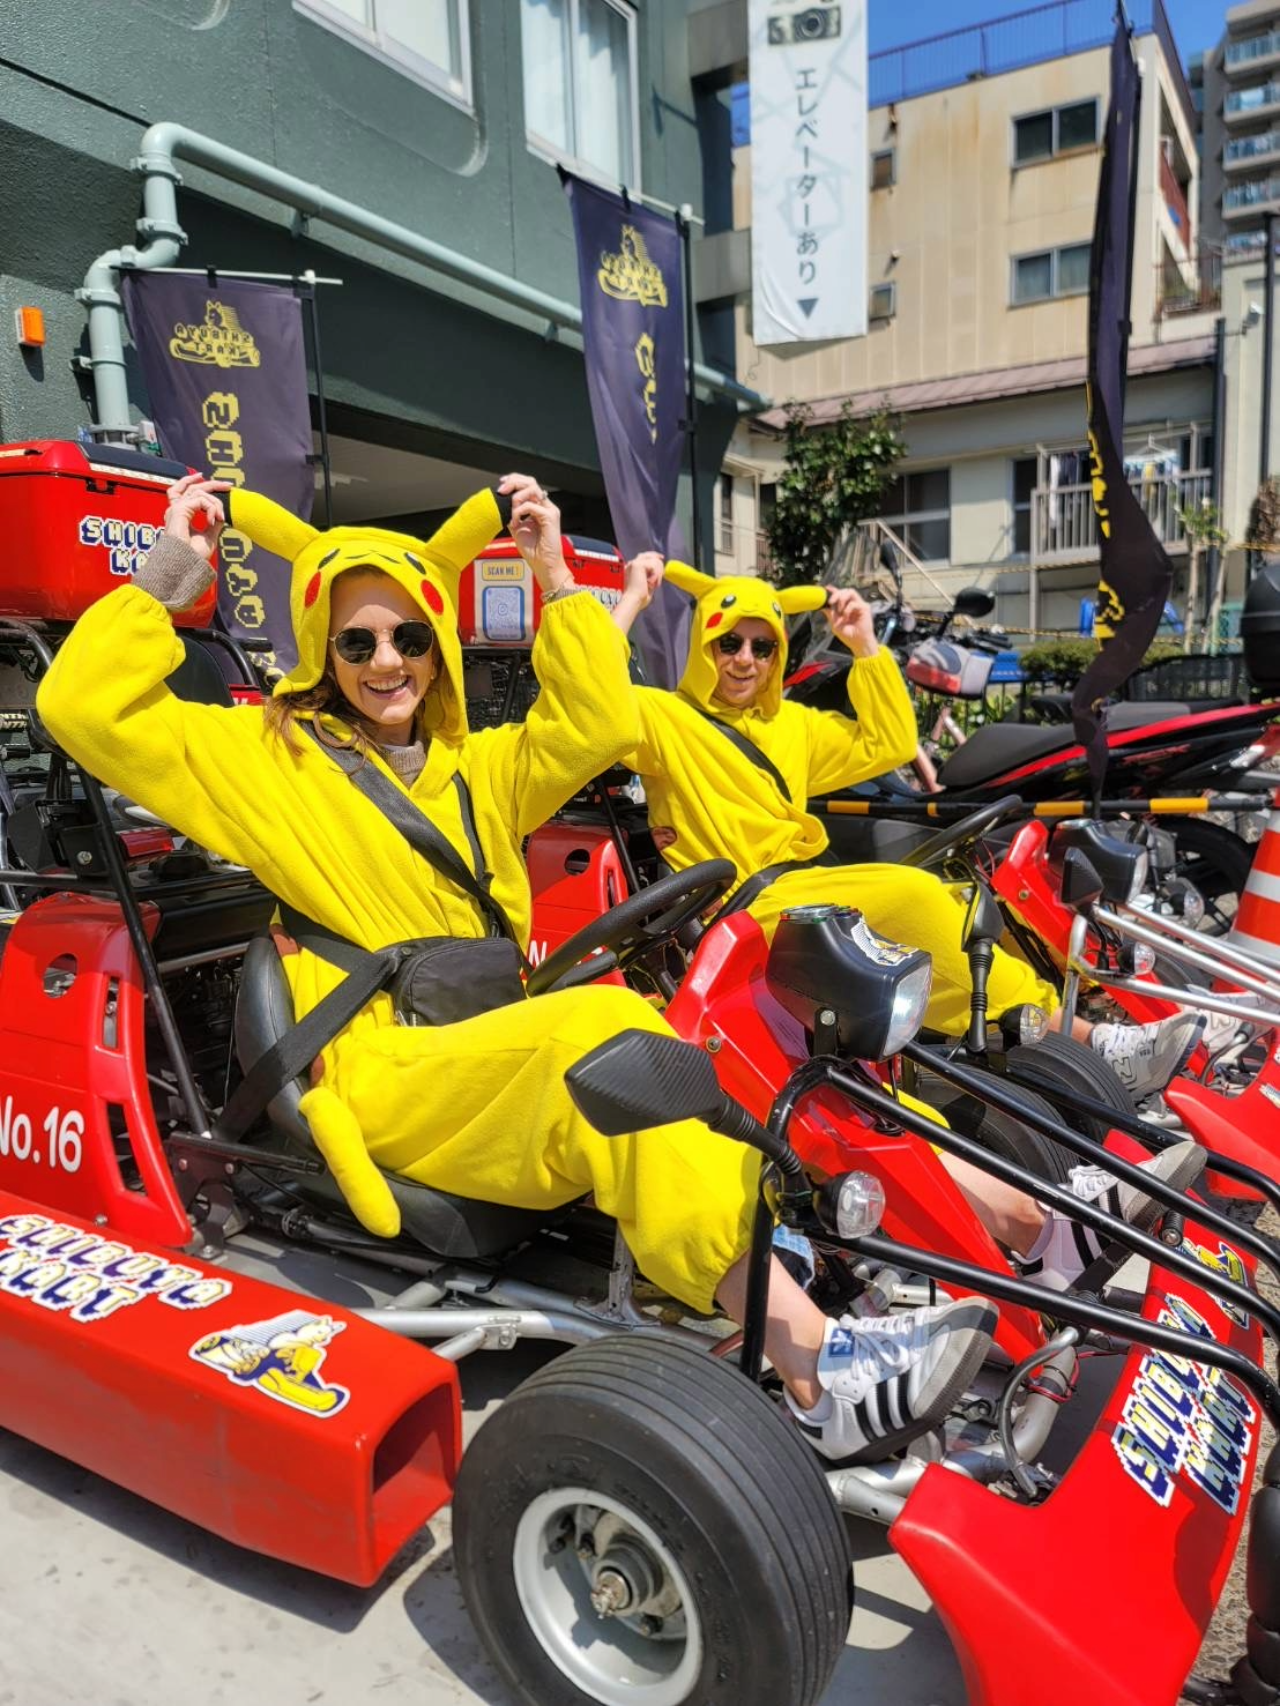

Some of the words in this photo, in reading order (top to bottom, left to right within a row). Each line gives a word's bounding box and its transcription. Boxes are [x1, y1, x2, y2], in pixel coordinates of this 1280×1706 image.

[796, 68, 819, 285] エレベーターあり
[80, 515, 164, 551] SHIB
[487, 565, 505, 576] SCAN
[0, 1214, 232, 1309] SHIBUYA
[0, 1248, 141, 1321] KART
